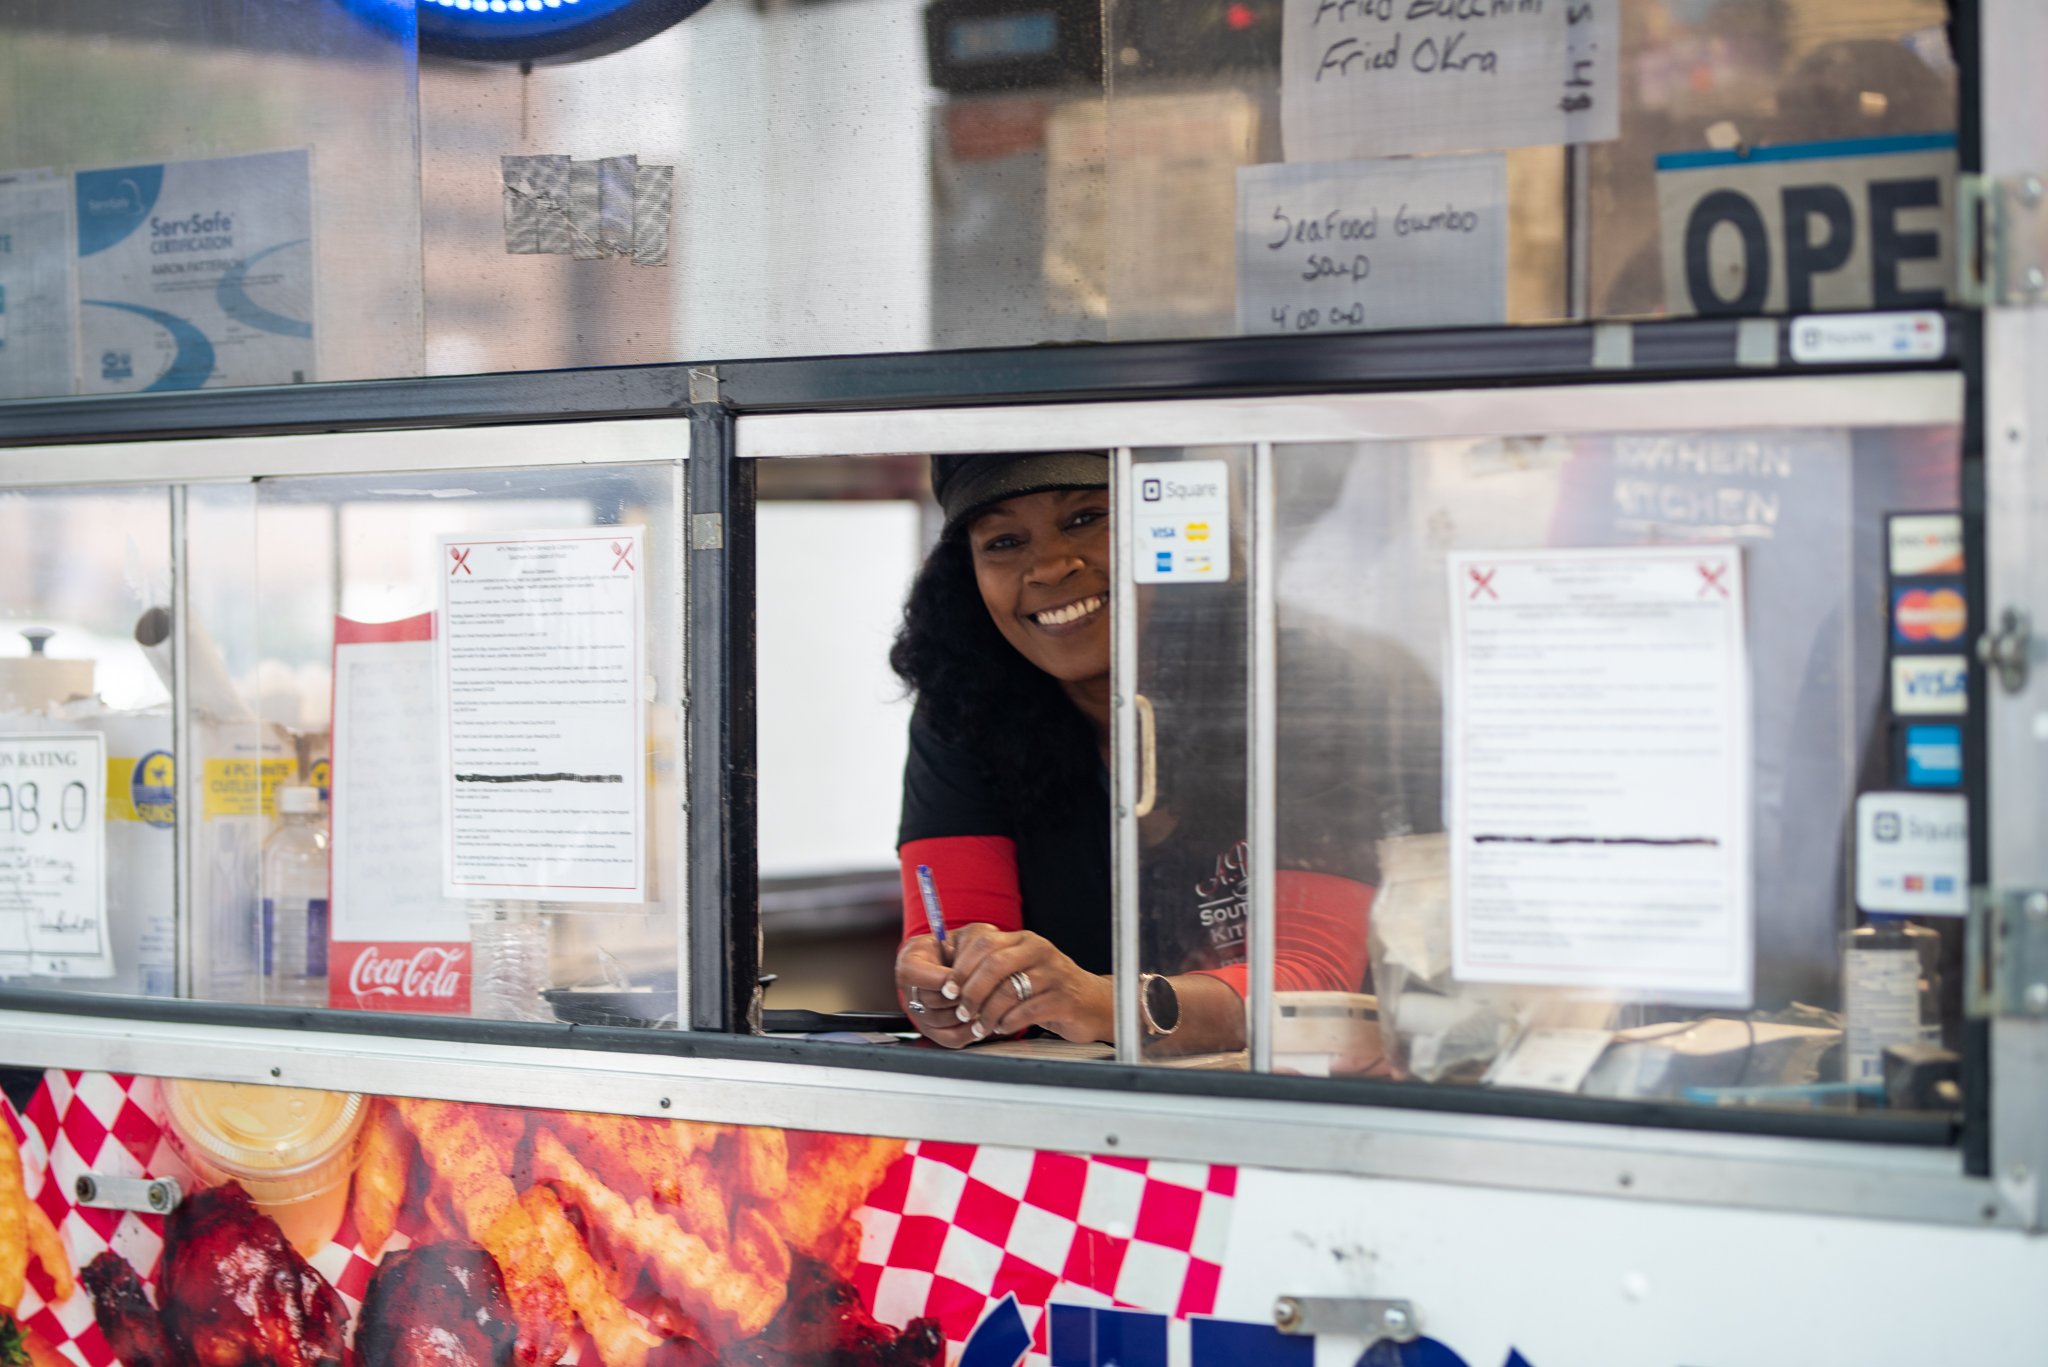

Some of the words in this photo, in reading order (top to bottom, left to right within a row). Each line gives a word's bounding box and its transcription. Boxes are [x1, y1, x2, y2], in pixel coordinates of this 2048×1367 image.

[1315, 32, 1401, 82] Fried
[150, 210, 233, 237] ServSafe
[1684, 176, 1946, 315] OPE
[1165, 481, 1218, 501] Square
[18, 751, 77, 768] RATING
[1199, 902, 1248, 926] SOUT
[1210, 924, 1245, 943] KIT
